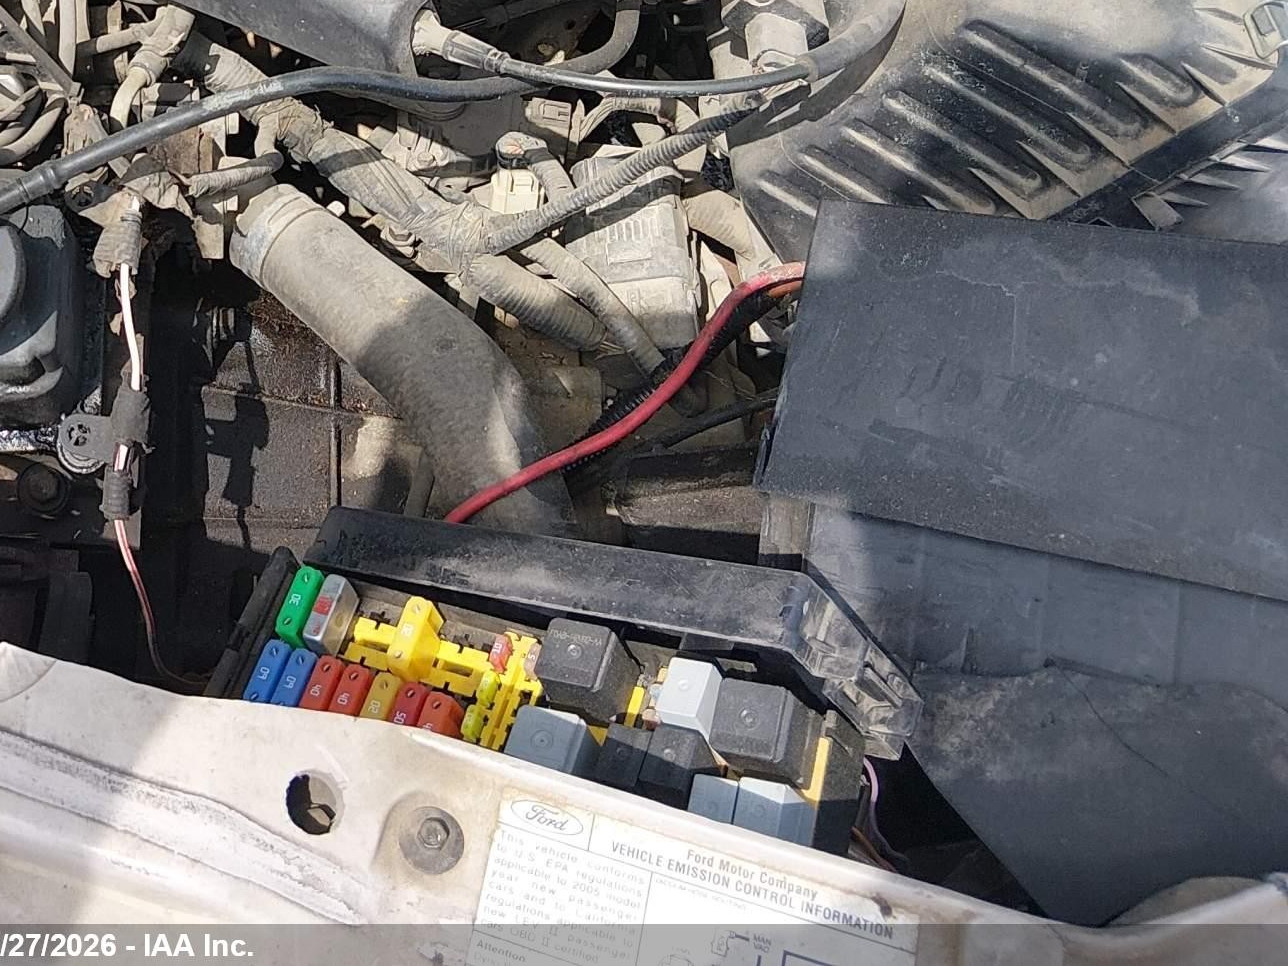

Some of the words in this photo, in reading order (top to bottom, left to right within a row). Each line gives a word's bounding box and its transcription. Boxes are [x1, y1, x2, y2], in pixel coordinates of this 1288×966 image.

[289, 593, 302, 606] 30
[258, 666, 271, 682] 60
[286, 675, 298, 690] 60
[309, 683, 322, 698] 40
[337, 692, 350, 706] 40
[367, 700, 381, 715] 20
[525, 804, 569, 831] Ford
[536, 845, 578, 863] vehicle
[492, 869, 519, 883] year
[532, 882, 556, 895] new
[494, 857, 551, 882] applicable
[572, 881, 600, 897] 2005
[606, 893, 641, 909] model
[546, 858, 569, 873] EPA
[576, 870, 642, 898] regulations
[686, 849, 714, 868] Ford
[719, 859, 756, 880] Motor
[760, 871, 819, 902] Company
[489, 881, 514, 895] cars
[523, 893, 546, 906] and
[612, 841, 664, 867] VEHICLE
[667, 858, 731, 889] EMISSION
[735, 878, 794, 909] CONTROL
[800, 900, 894, 939] INFORMATION
[486, 893, 550, 921] regulations
[476, 939, 527, 963] Attention
